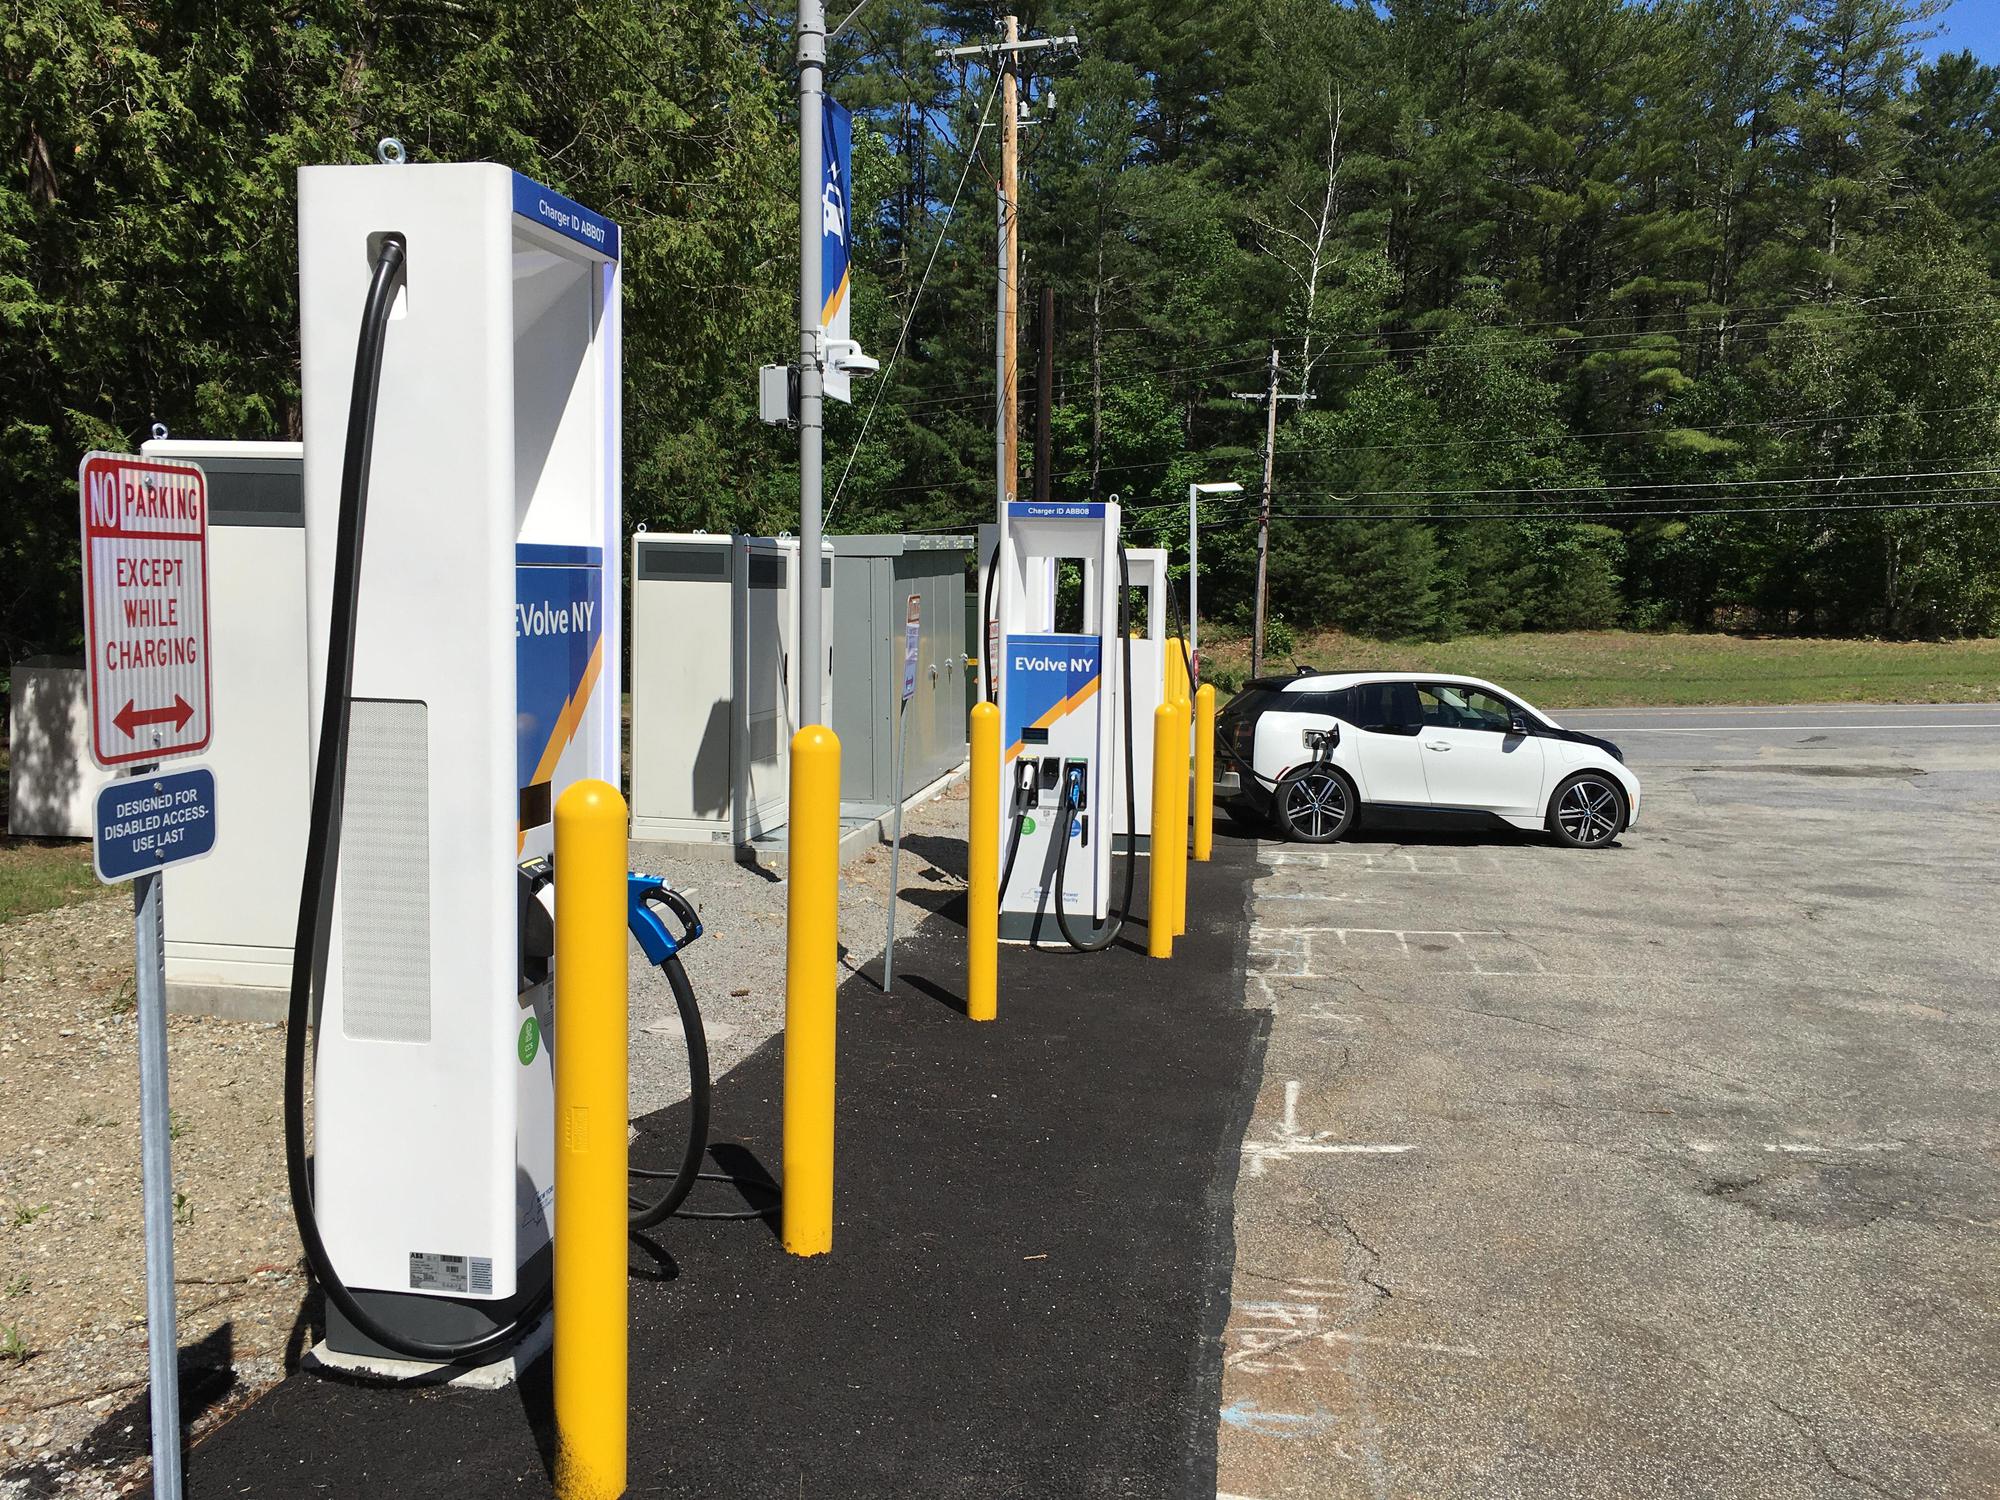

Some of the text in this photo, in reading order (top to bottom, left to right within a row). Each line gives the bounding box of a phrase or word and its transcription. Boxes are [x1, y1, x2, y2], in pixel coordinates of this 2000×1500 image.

[539, 199, 605, 243] Charger ID ABB07
[90, 470, 197, 528] NO PARKING
[1028, 507, 1055, 516] Charger
[116, 558, 183, 588] EXCEPT
[124, 598, 178, 628] WHILE
[572, 601, 595, 633] NY
[106, 636, 196, 671] CHARGING
[1015, 656, 1068, 672] EVolve
[1070, 658, 1094, 673] NY
[116, 788, 198, 819] DESIGNED FOR
[104, 804, 209, 841] DISABLED ACCESS-
[132, 827, 185, 853] USE LAST
